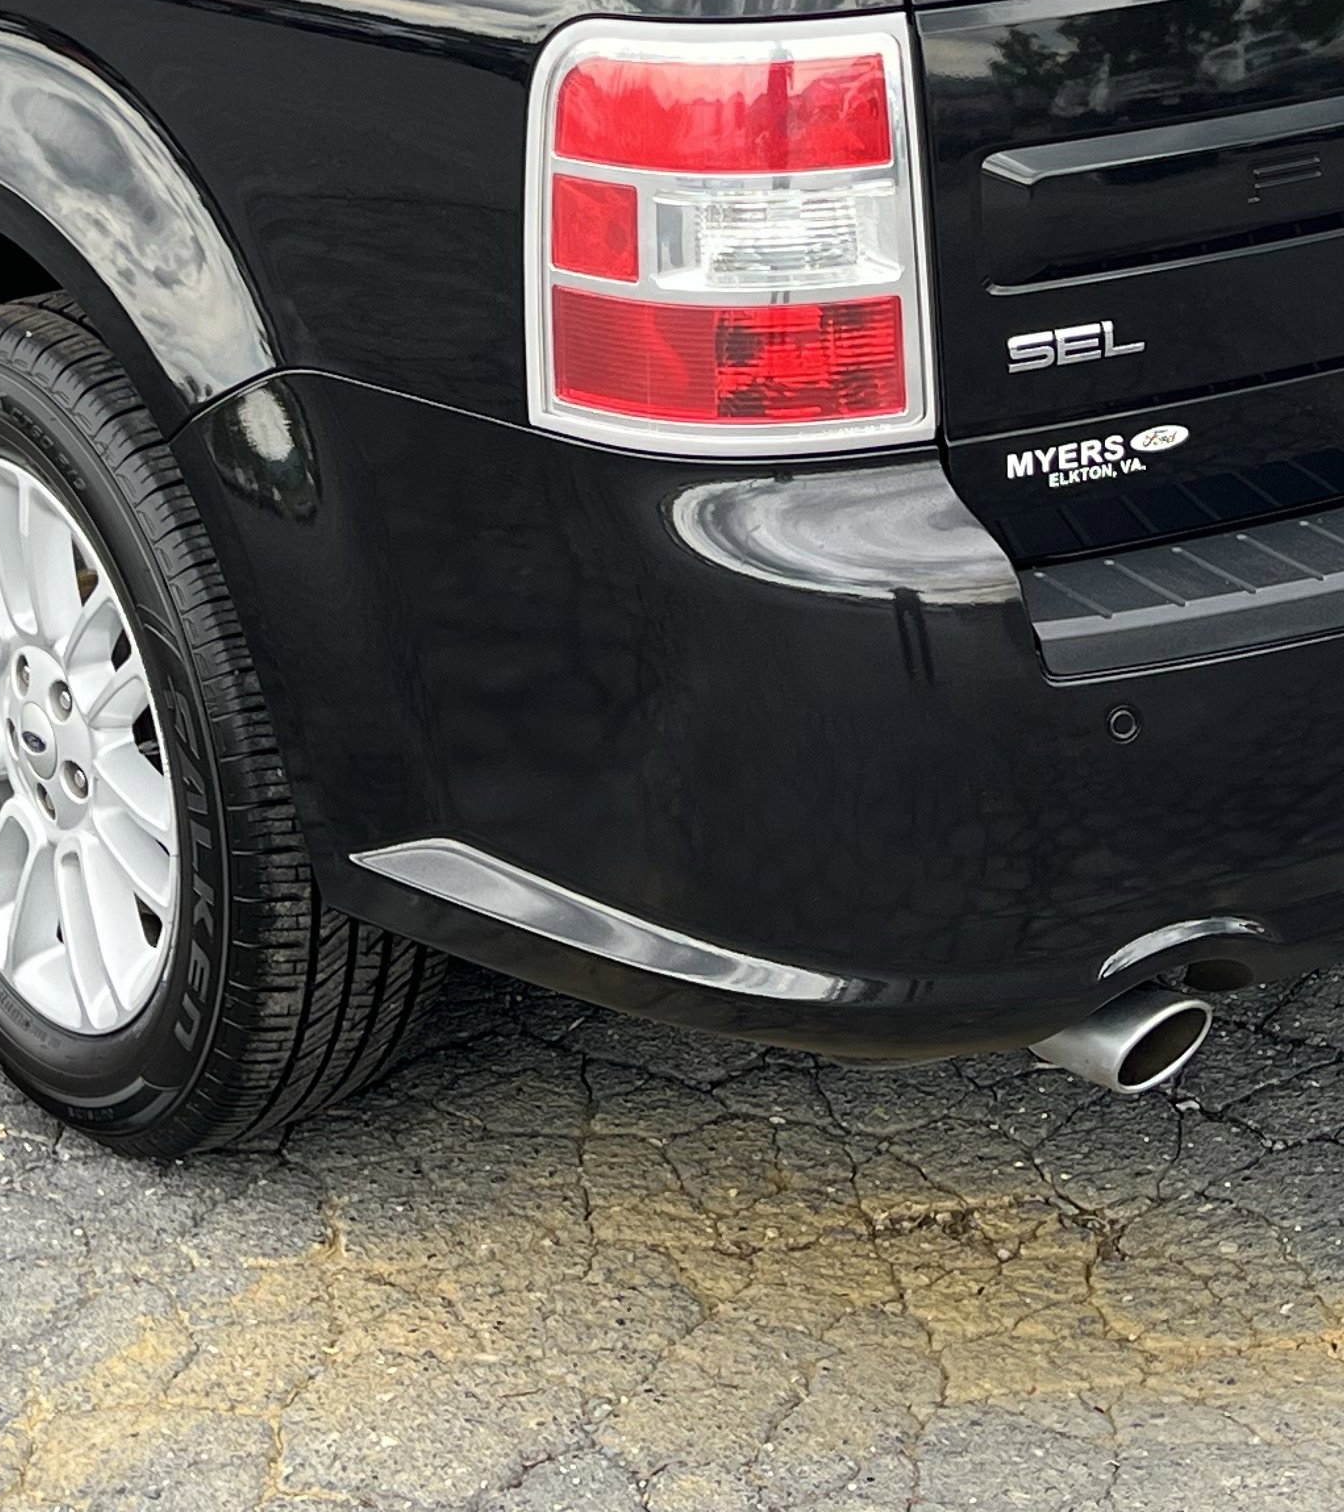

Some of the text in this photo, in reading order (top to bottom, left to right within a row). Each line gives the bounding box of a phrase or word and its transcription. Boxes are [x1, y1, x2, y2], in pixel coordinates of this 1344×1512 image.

[1006, 320, 1146, 374] SEL
[1006, 434, 1126, 480] MYERS
[1048, 456, 1147, 489] ELKTON, VA.
[166, 672, 215, 1052] FALKEN
